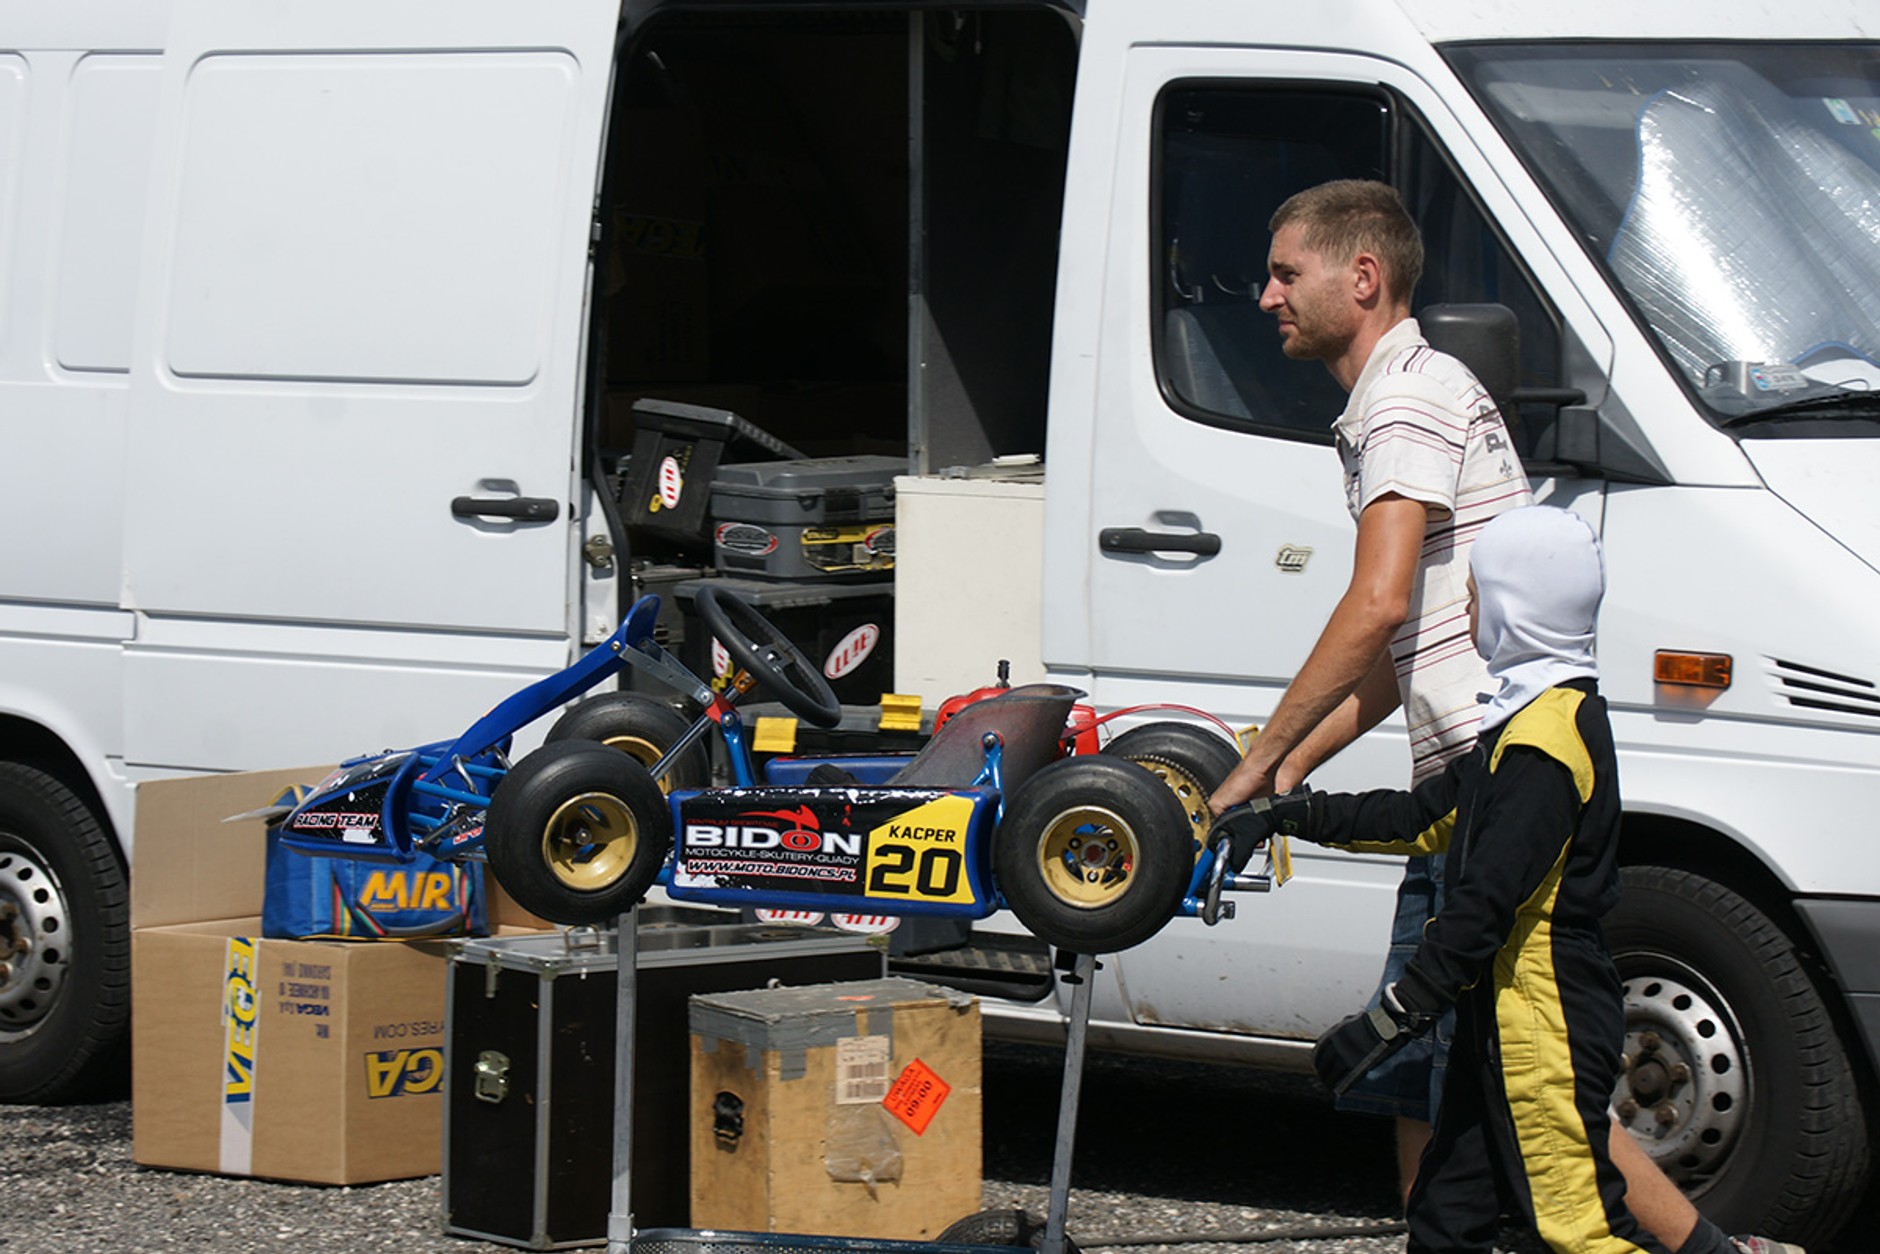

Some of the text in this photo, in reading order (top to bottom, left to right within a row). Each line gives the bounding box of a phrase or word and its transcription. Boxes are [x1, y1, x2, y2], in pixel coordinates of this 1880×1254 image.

[338, 812, 379, 829] TEAM
[888, 825, 956, 842] KACPER
[686, 825, 862, 855] BIDON
[685, 847, 860, 865] MOTOCYKLE-SKUTERY-QUADY
[869, 844, 962, 897] 20
[359, 871, 453, 910] MIR
[365, 1047, 444, 1098] GA
